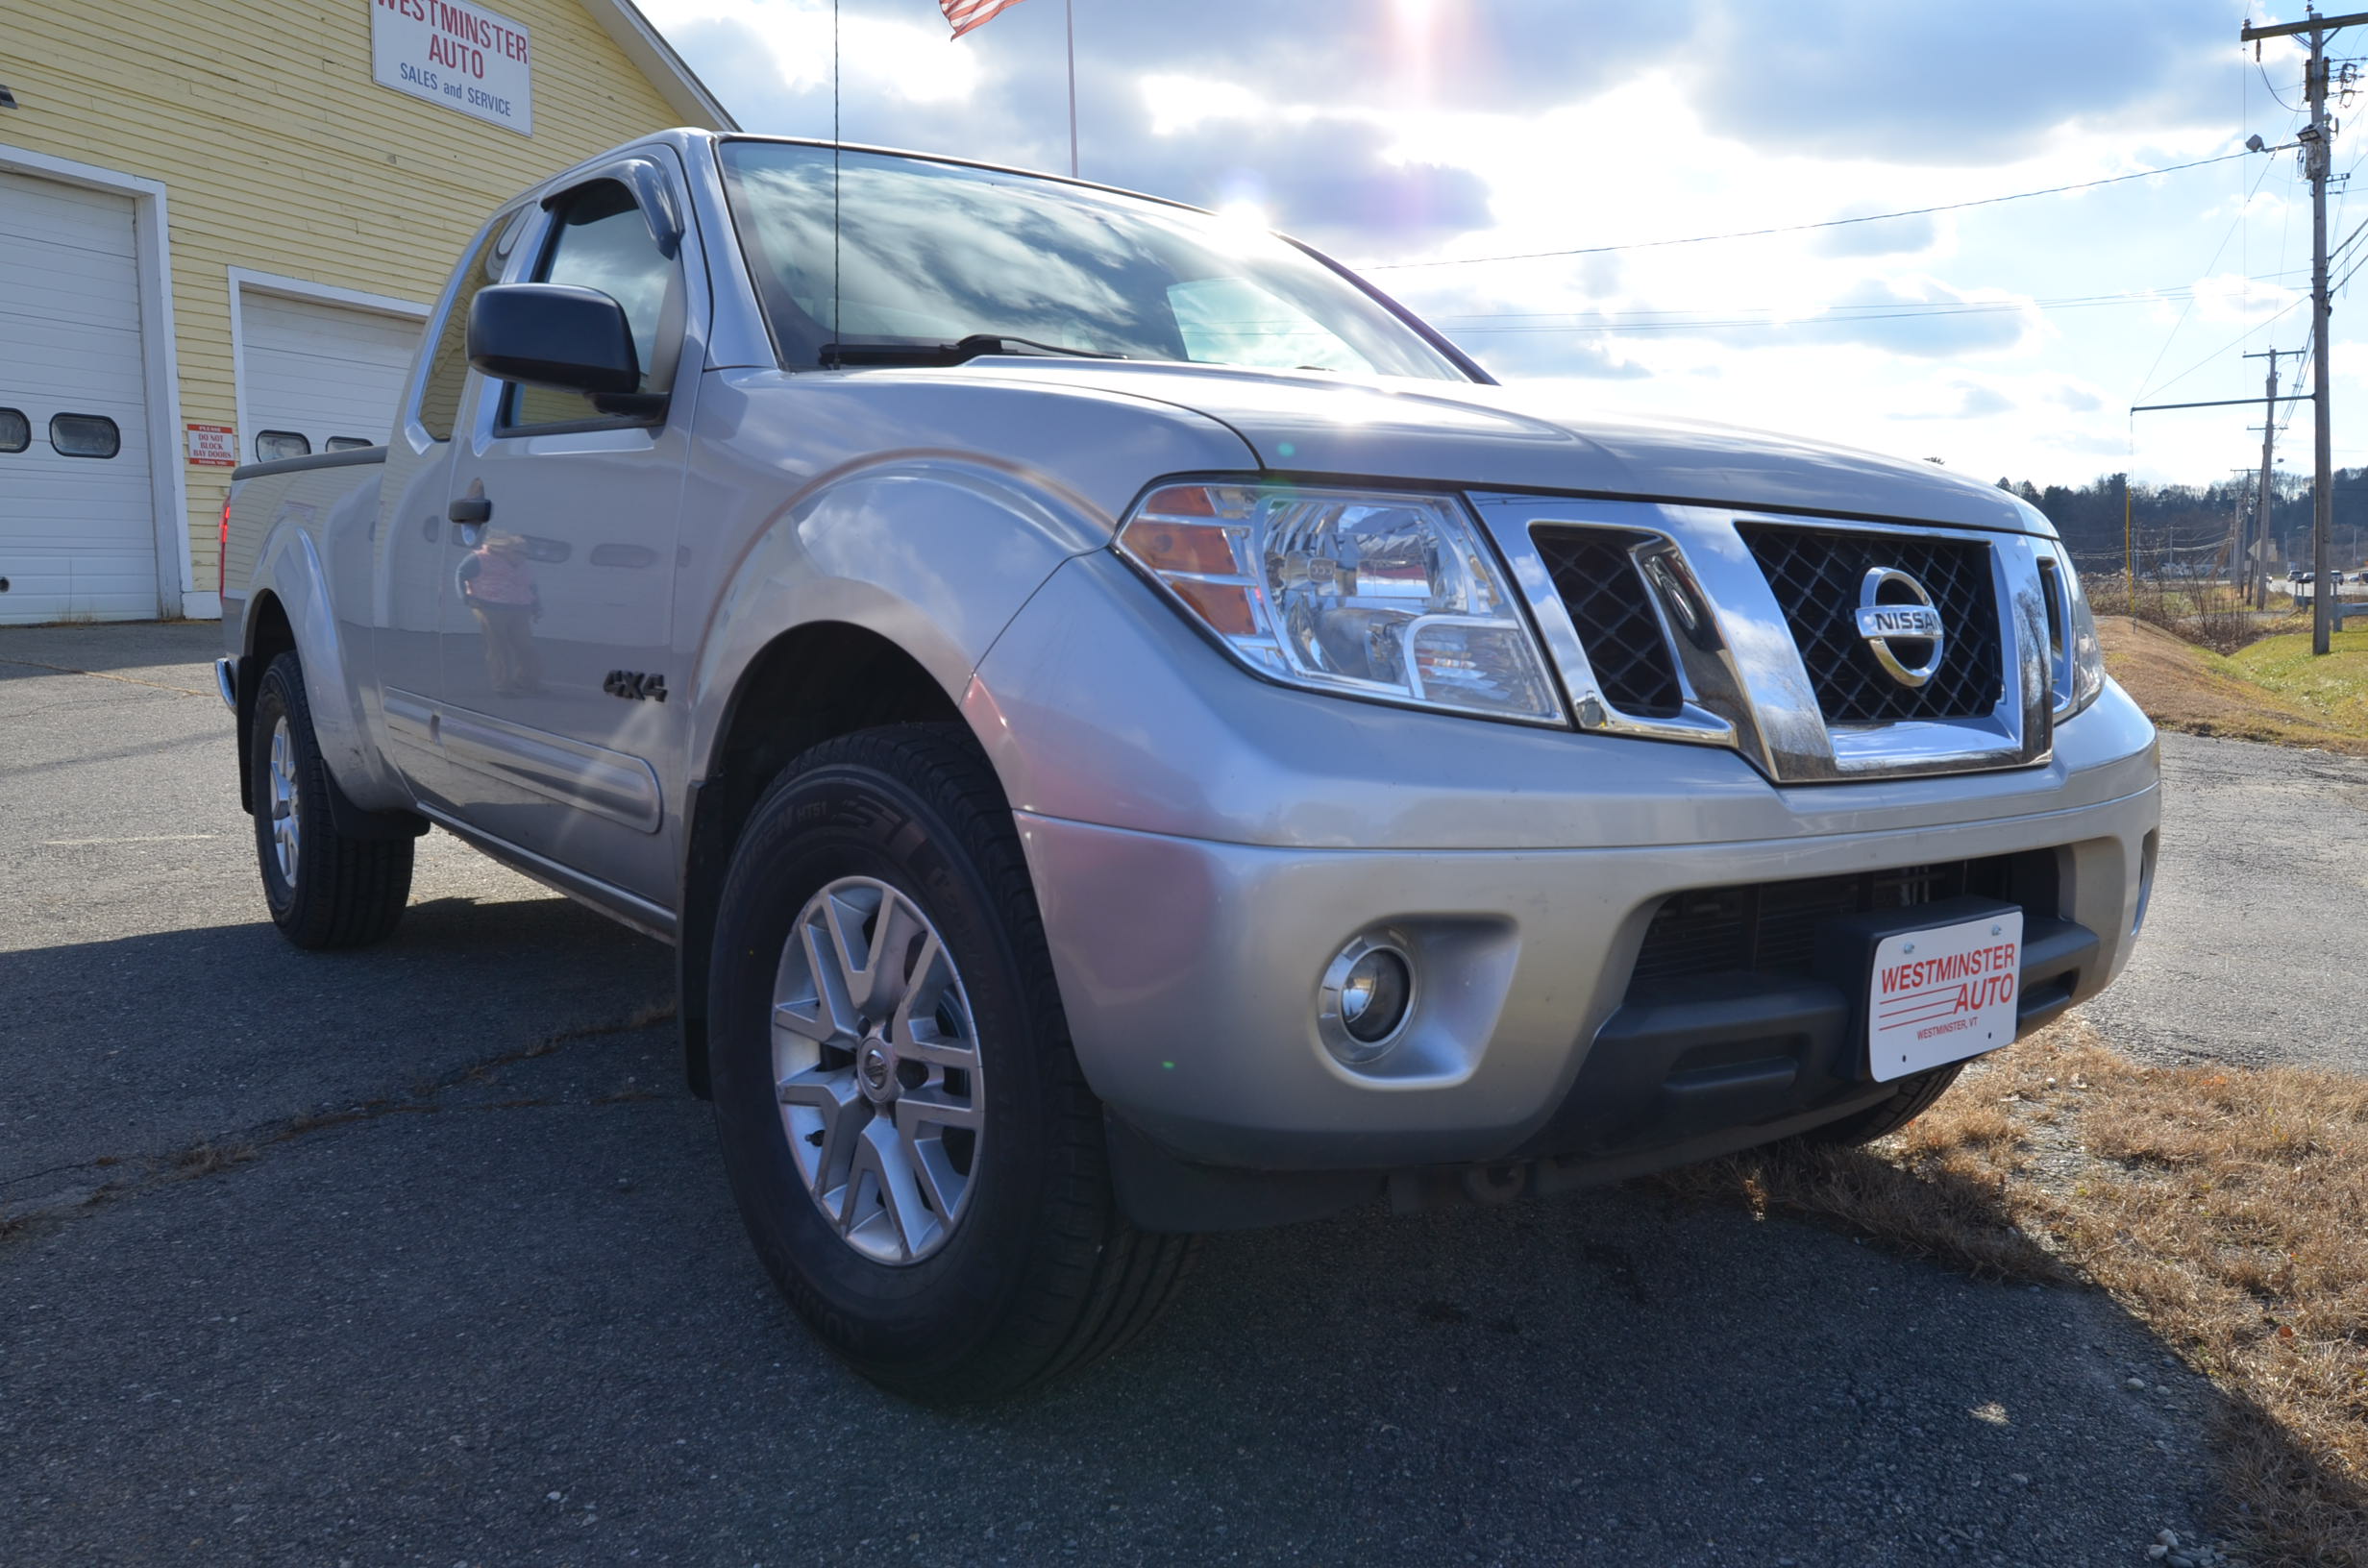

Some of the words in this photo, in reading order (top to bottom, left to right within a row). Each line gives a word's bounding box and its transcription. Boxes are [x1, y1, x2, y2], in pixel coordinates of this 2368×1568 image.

[429, 34, 484, 80] AUTO
[400, 61, 438, 90] SALES
[443, 82, 462, 99] and
[468, 87, 511, 117] SERVICE
[200, 442, 223, 451] BLOCK
[1874, 612, 1941, 631] NISSAN
[603, 670, 668, 702] 4X4
[1882, 943, 2015, 994] WESTMINSTER
[1953, 973, 2014, 1015] AUTO
[1916, 1019, 1968, 1041] WESTMINSTER,
[1970, 1017, 1978, 1027] VT
